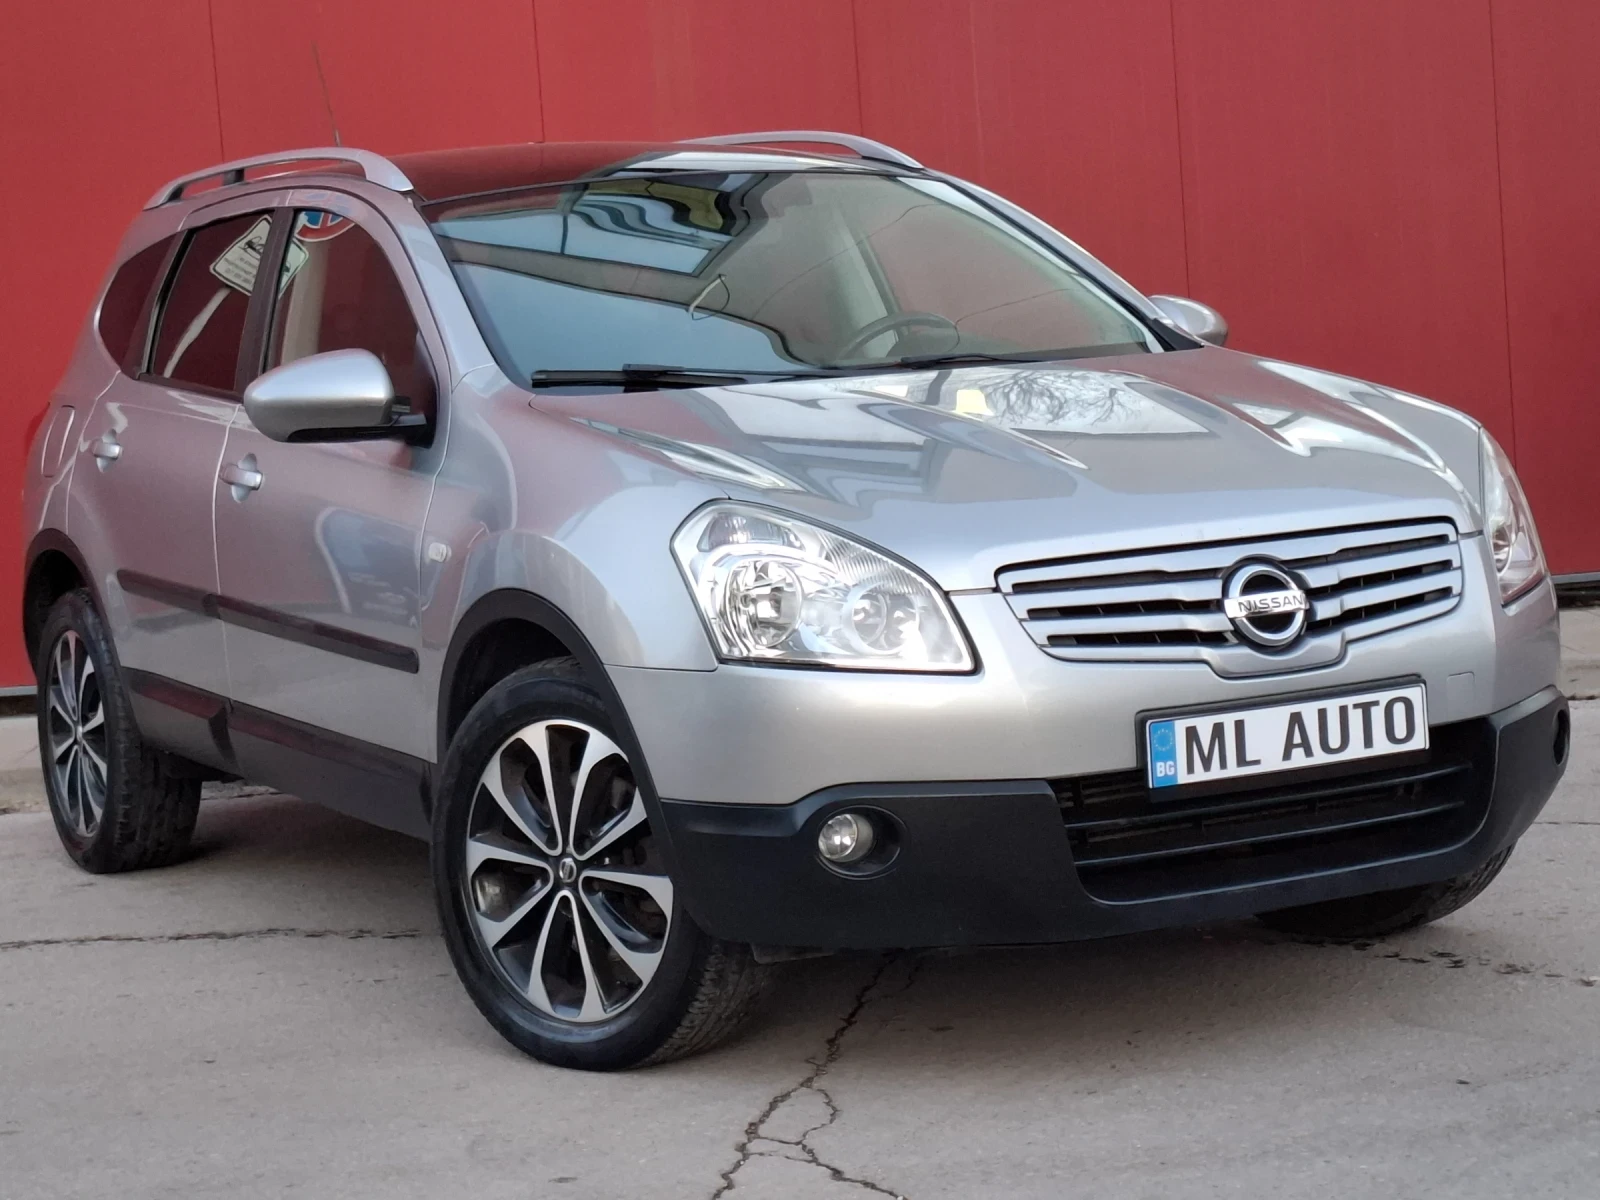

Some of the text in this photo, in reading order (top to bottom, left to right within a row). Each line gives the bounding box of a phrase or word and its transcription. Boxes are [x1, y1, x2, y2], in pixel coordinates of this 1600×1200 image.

[1238, 595, 1304, 613] NISSAN
[1185, 696, 1416, 775] ML AUTO
[1156, 761, 1175, 777] BG
